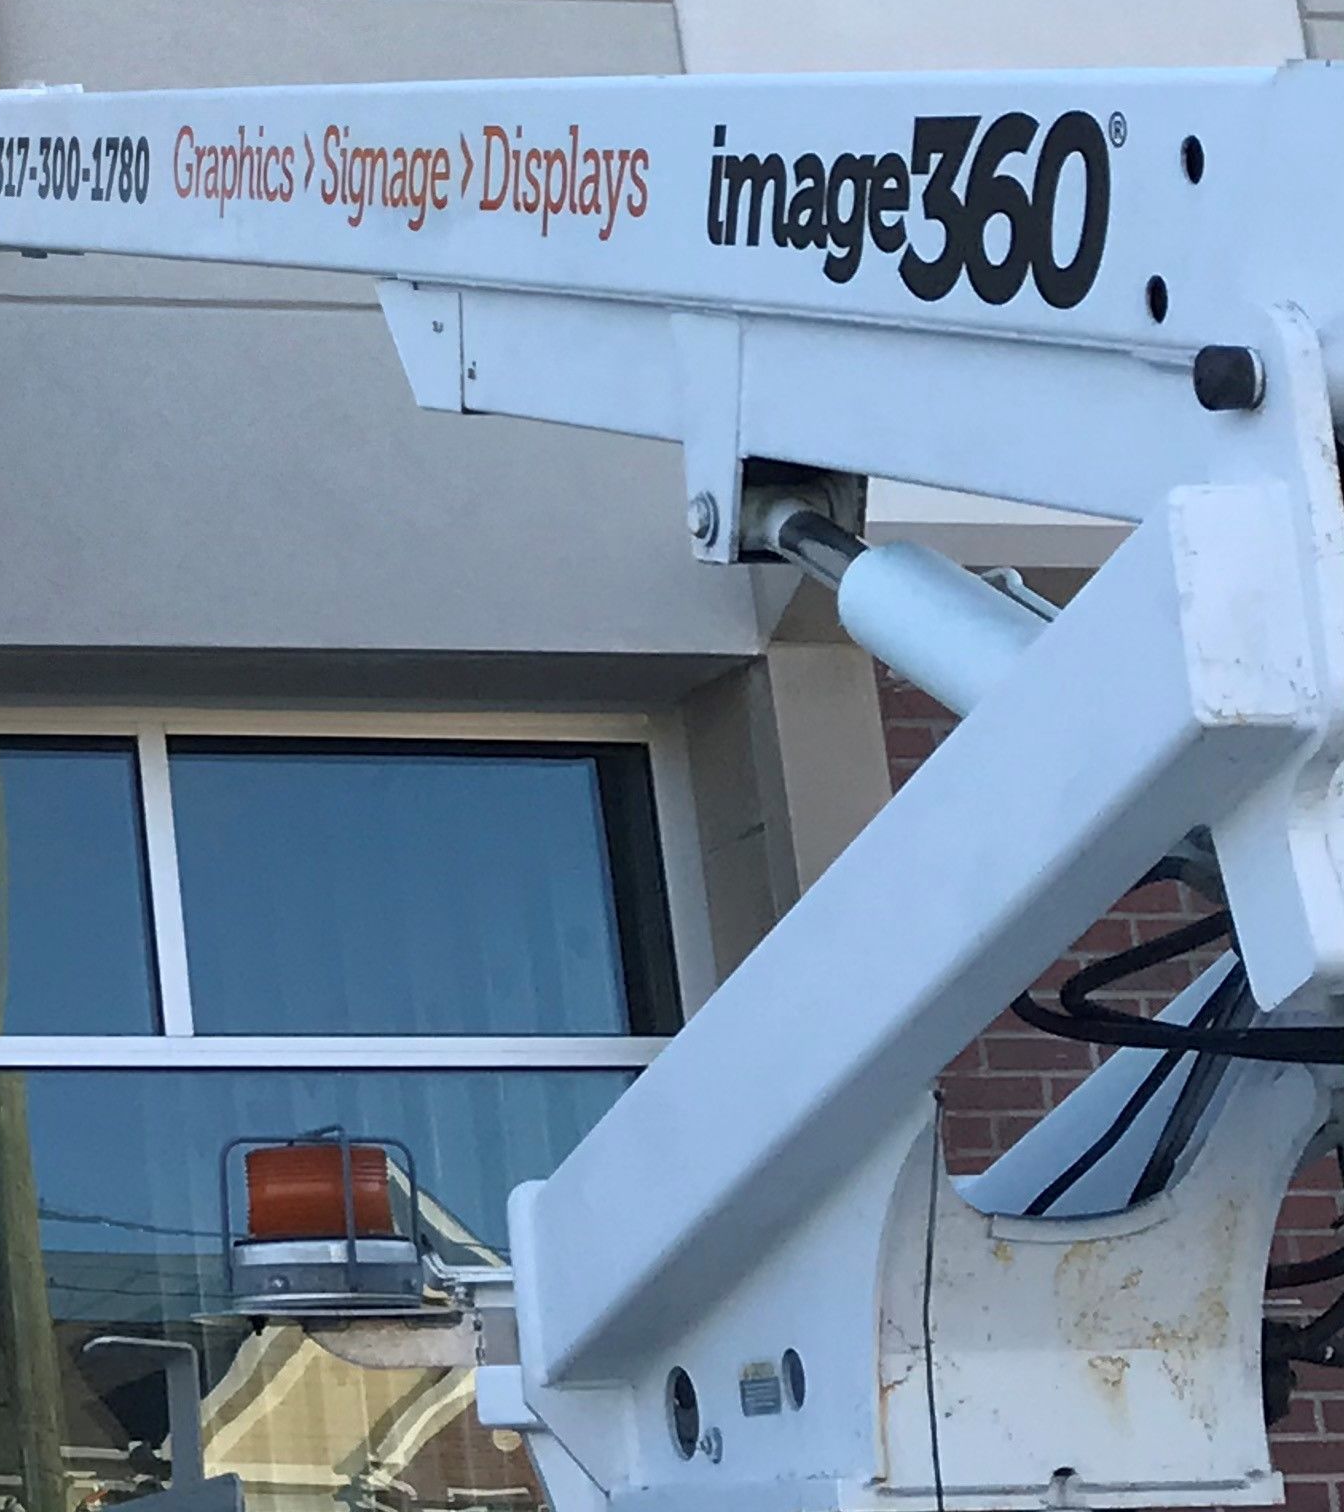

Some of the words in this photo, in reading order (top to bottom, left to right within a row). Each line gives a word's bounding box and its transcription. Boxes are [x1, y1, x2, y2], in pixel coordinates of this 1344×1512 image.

[172, 124, 295, 219] Graphics
[320, 124, 452, 232] Signage
[479, 124, 650, 242] Displays
